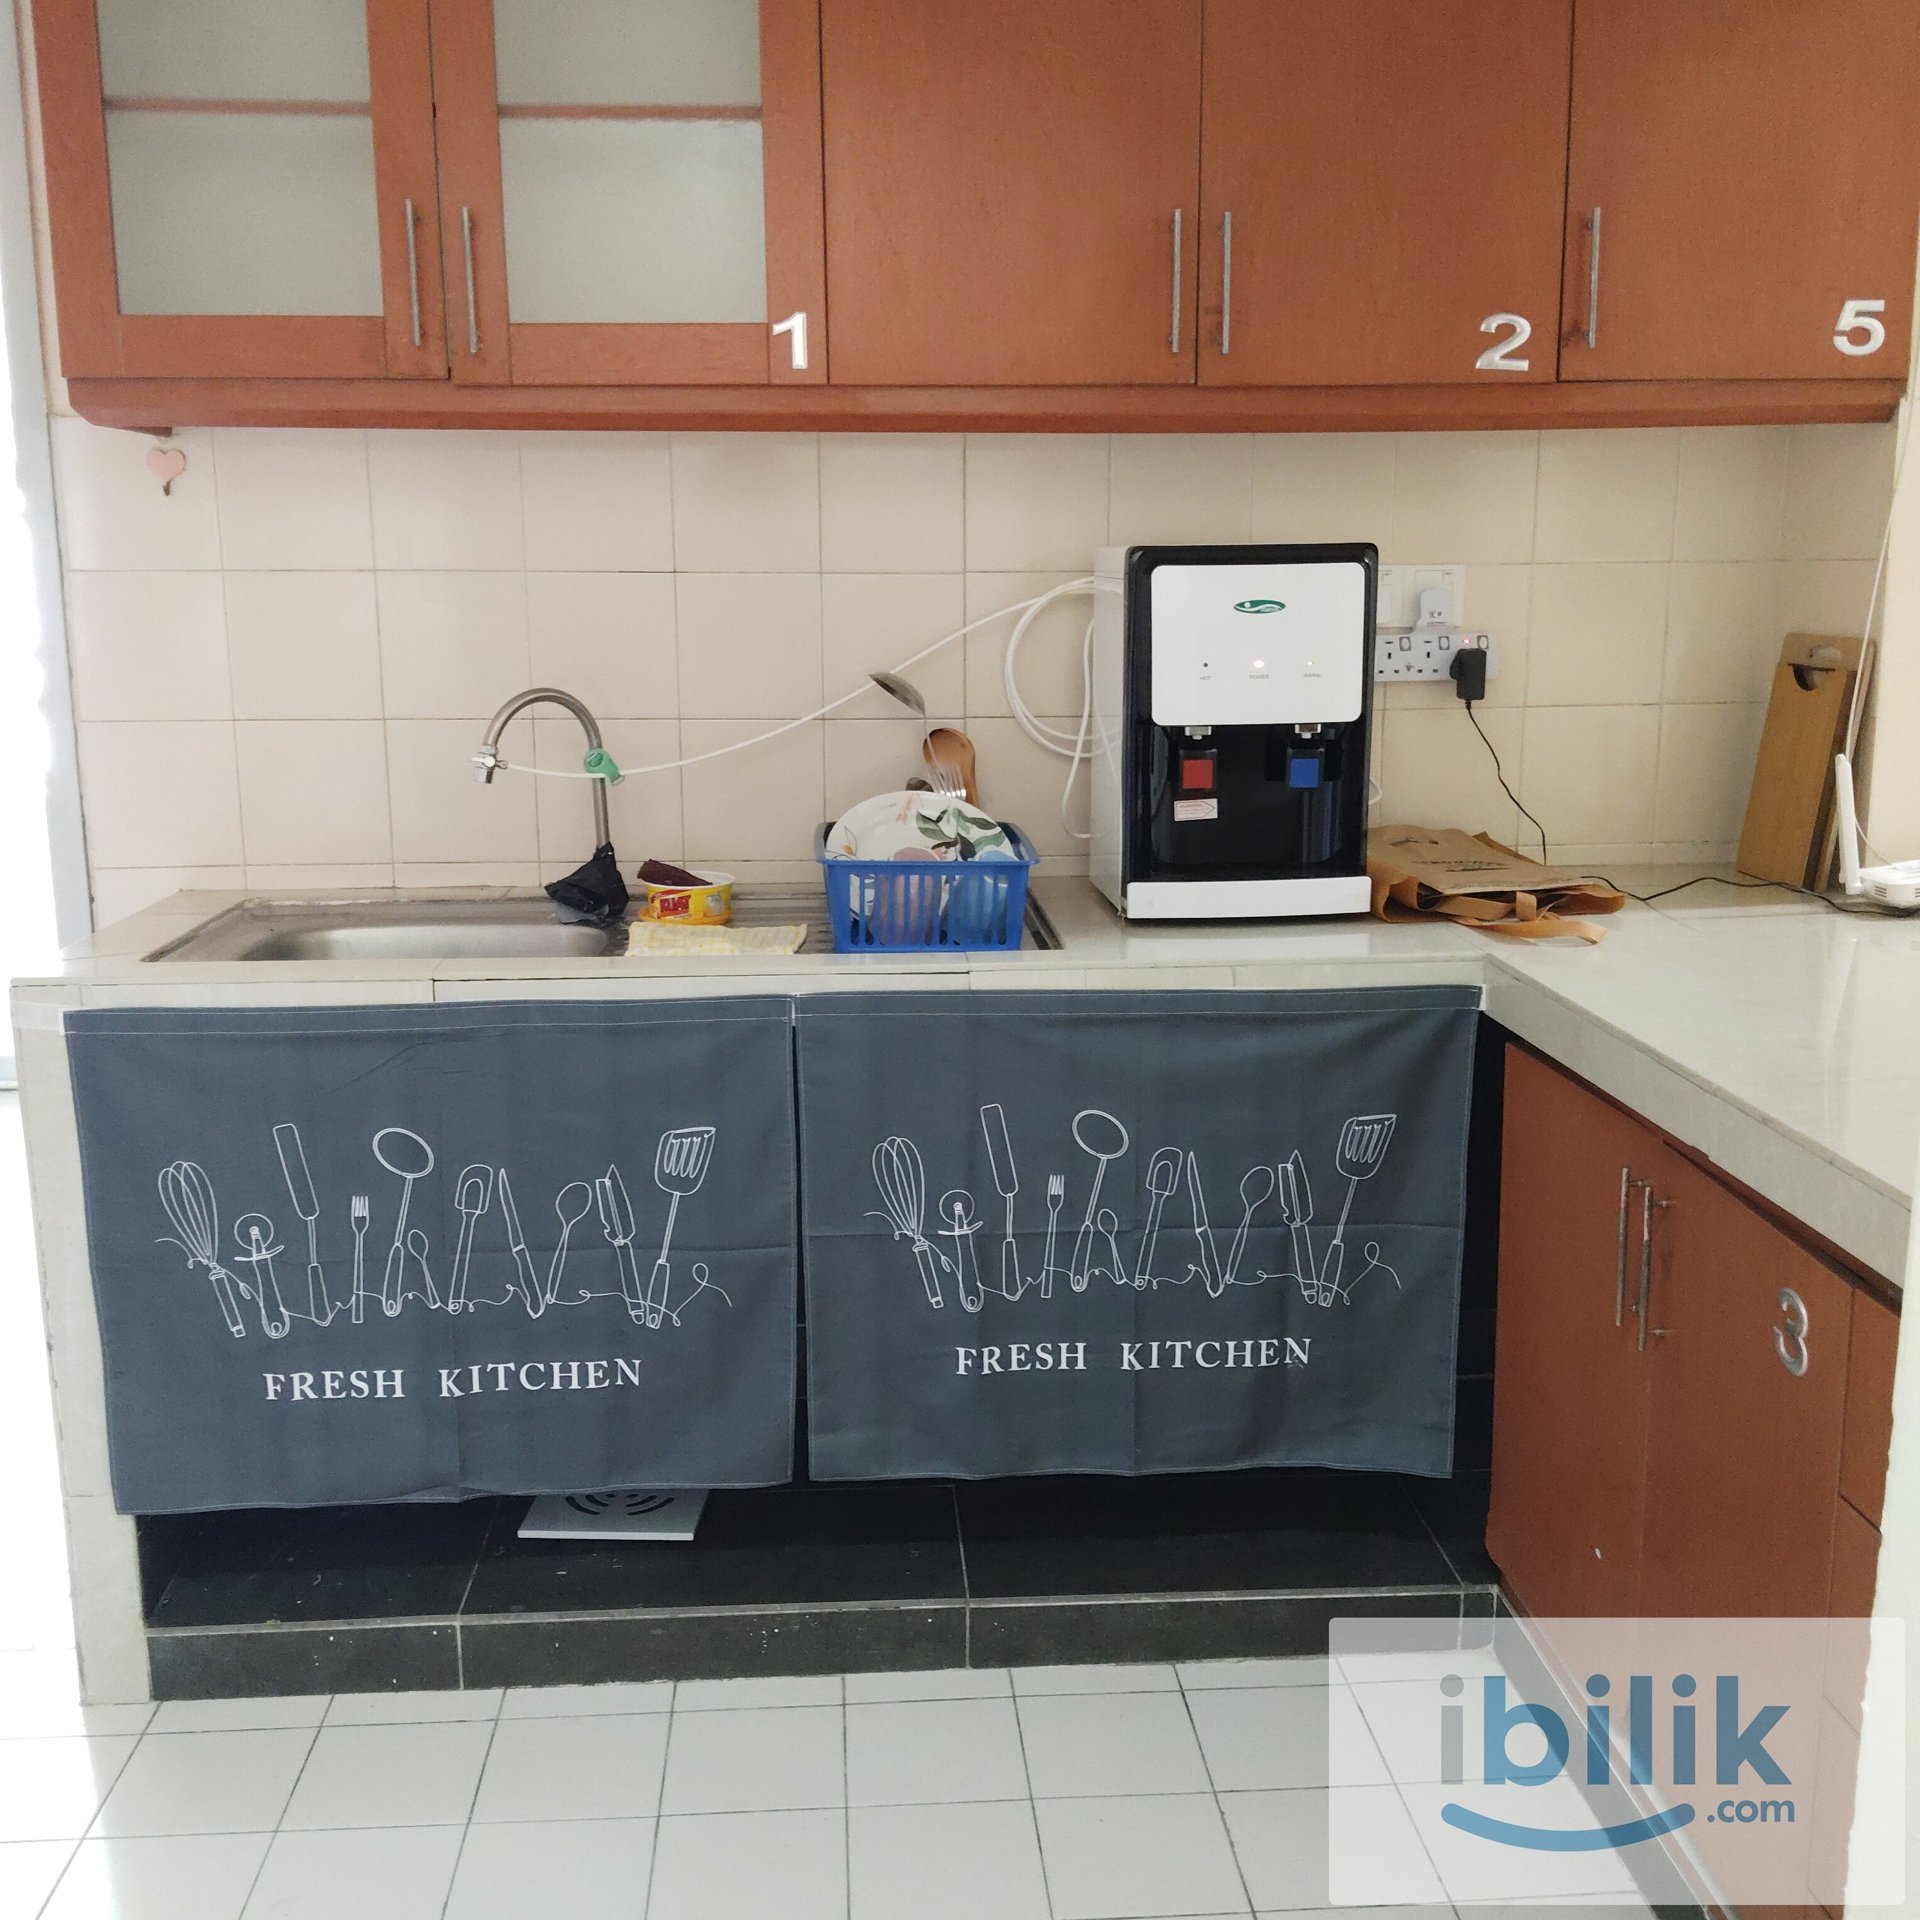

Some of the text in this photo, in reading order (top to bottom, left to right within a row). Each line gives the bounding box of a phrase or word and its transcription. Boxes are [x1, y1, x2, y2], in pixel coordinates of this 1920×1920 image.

[772, 312, 808, 370] 1
[1475, 313, 1532, 372] 2
[1832, 299, 1886, 357] 5
[955, 1337, 1311, 1376] FRESH KITCHEN
[1773, 1287, 1809, 1377] 3
[263, 1358, 641, 1401] FRESH KITCHEN
